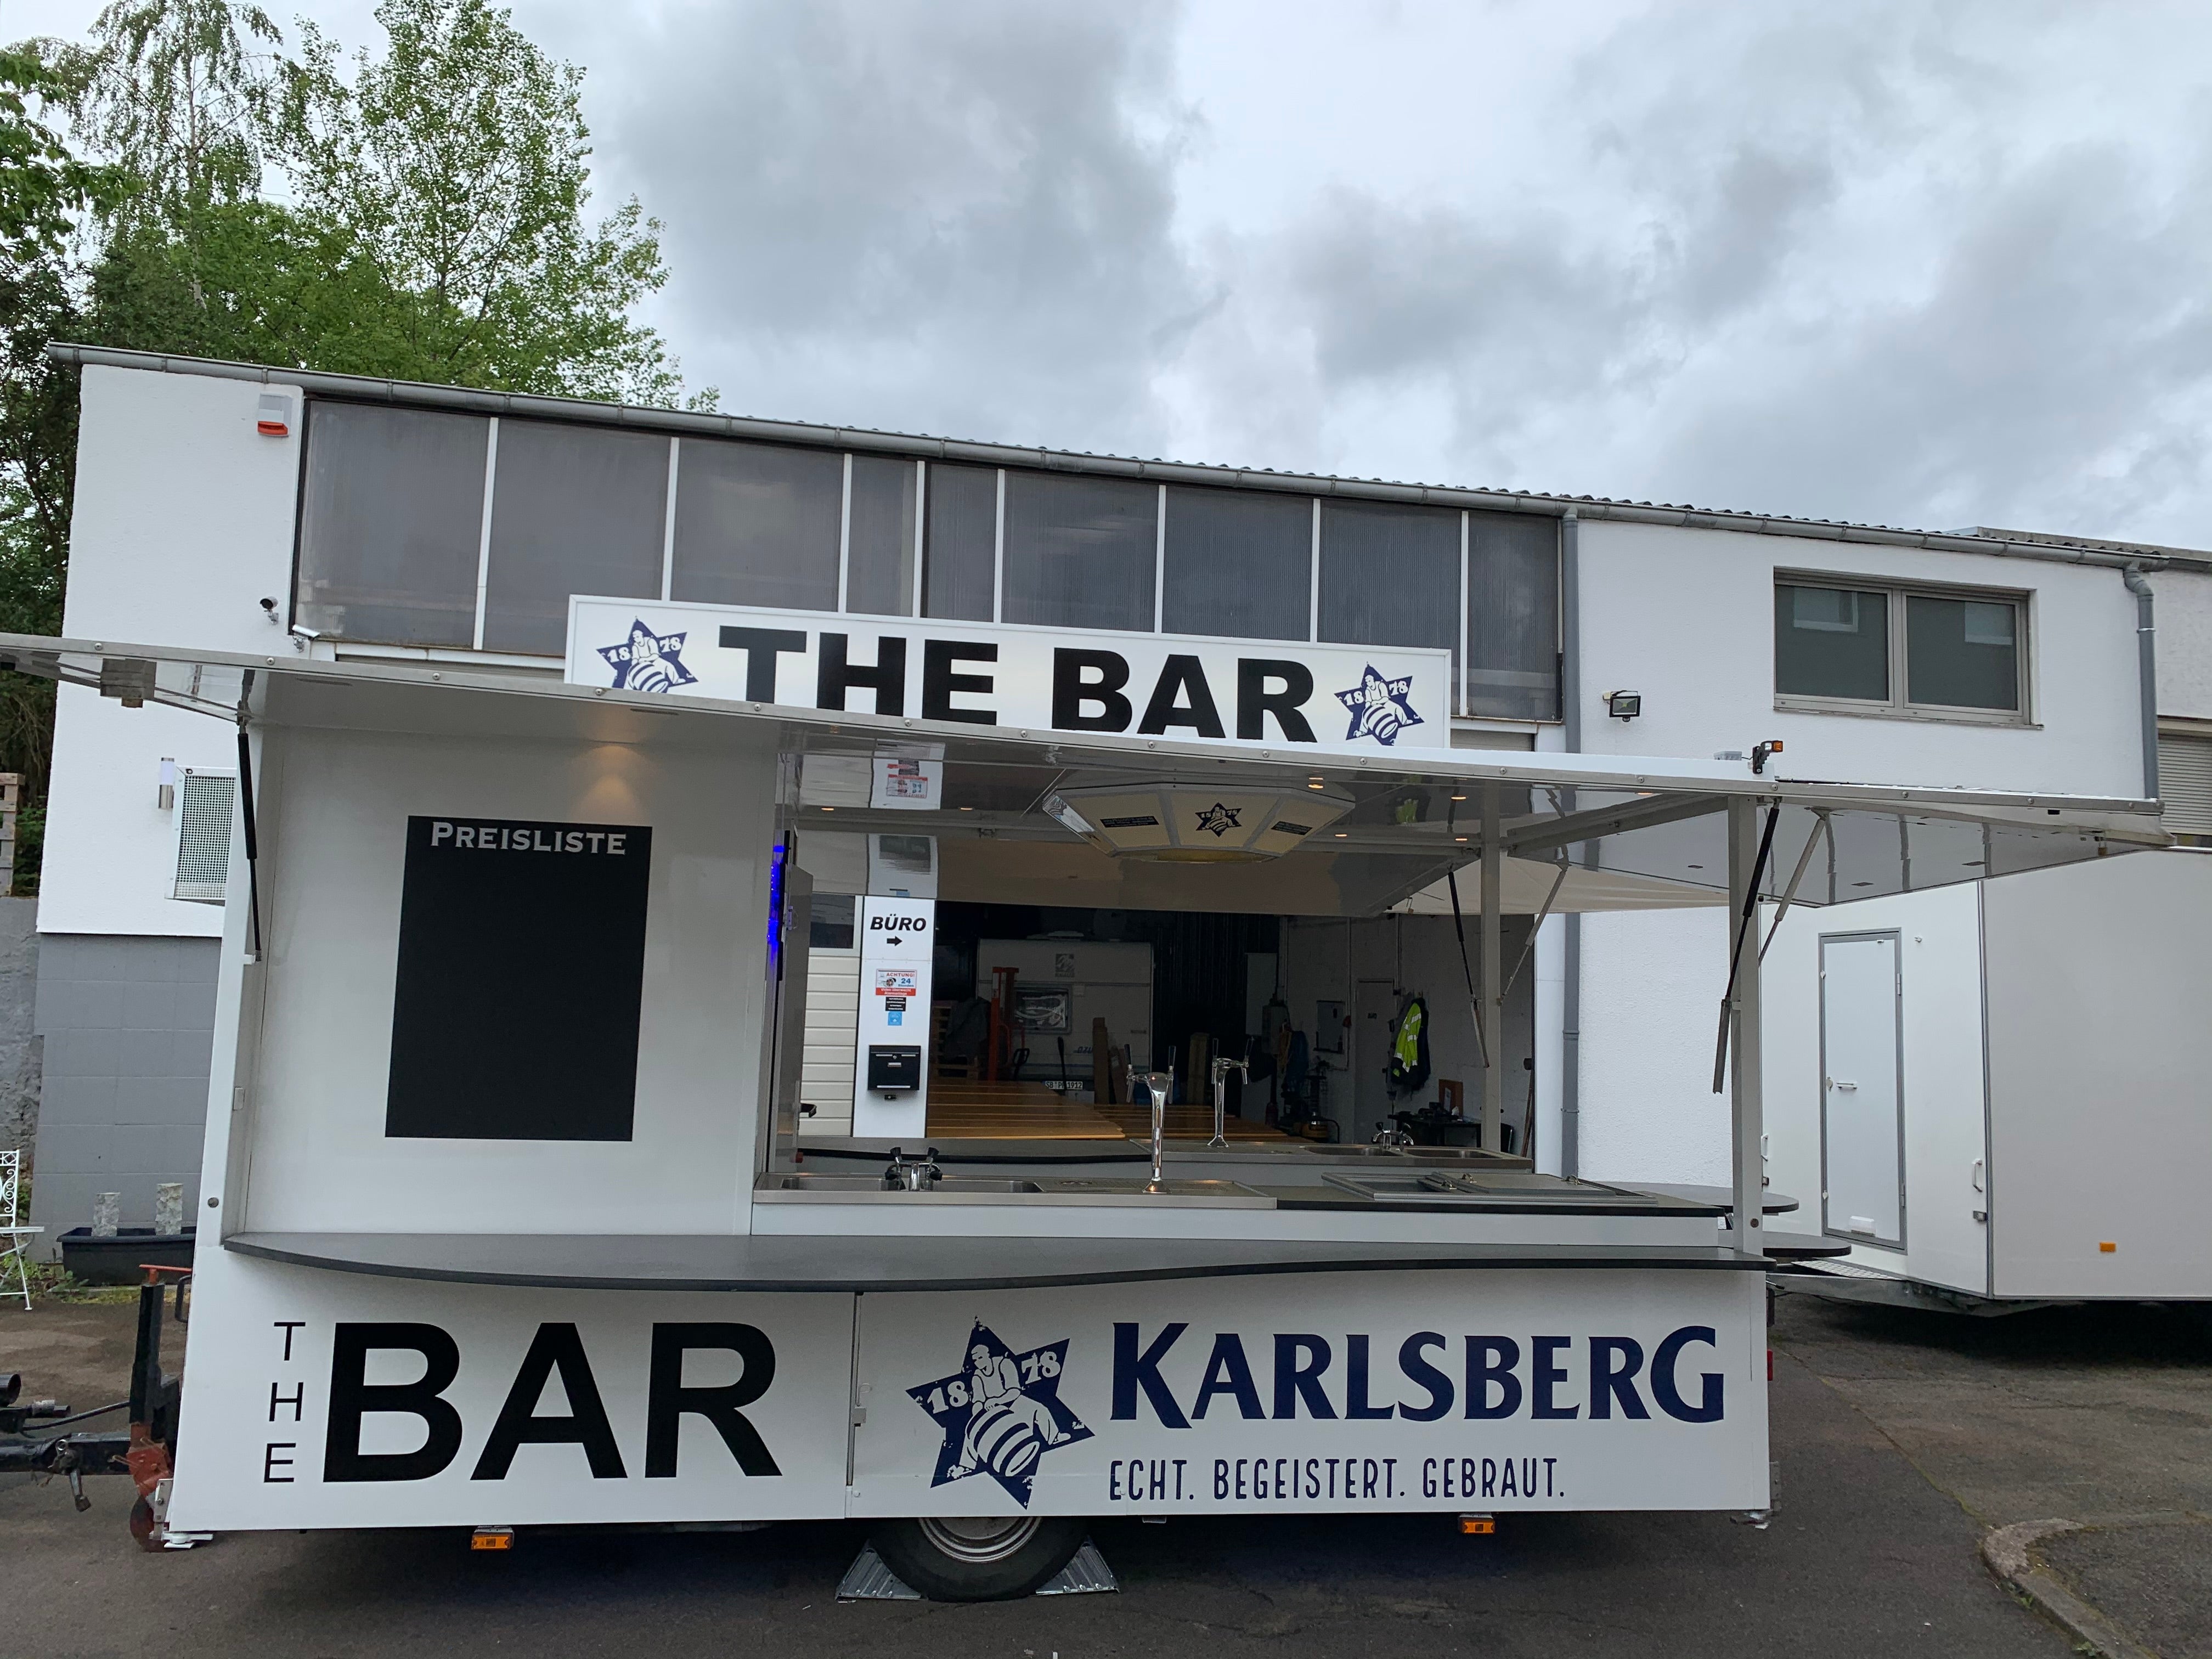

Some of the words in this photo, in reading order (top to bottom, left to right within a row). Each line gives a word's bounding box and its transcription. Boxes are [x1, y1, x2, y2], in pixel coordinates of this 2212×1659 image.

[607, 647, 630, 663] 18
[659, 636, 682, 652] 78
[719, 625, 998, 725] THE
[1052, 647, 1317, 743] BAR
[1344, 691, 1364, 706] 18
[1389, 680, 1408, 696] 78
[431, 822, 627, 855] PREISLISTE
[870, 914, 926, 931] BÜRO
[927, 1381, 969, 1413] 18
[1022, 1351, 1060, 1384] 78
[1110, 1323, 1724, 1429] KARLSBERG
[264, 1322, 306, 1483] THE
[323, 1322, 783, 1482] BAR
[1110, 1459, 1194, 1501] ECHT.
[1214, 1459, 1405, 1500] BEGEISTERT.
[1423, 1458, 1564, 1498] GEBRAUT.
